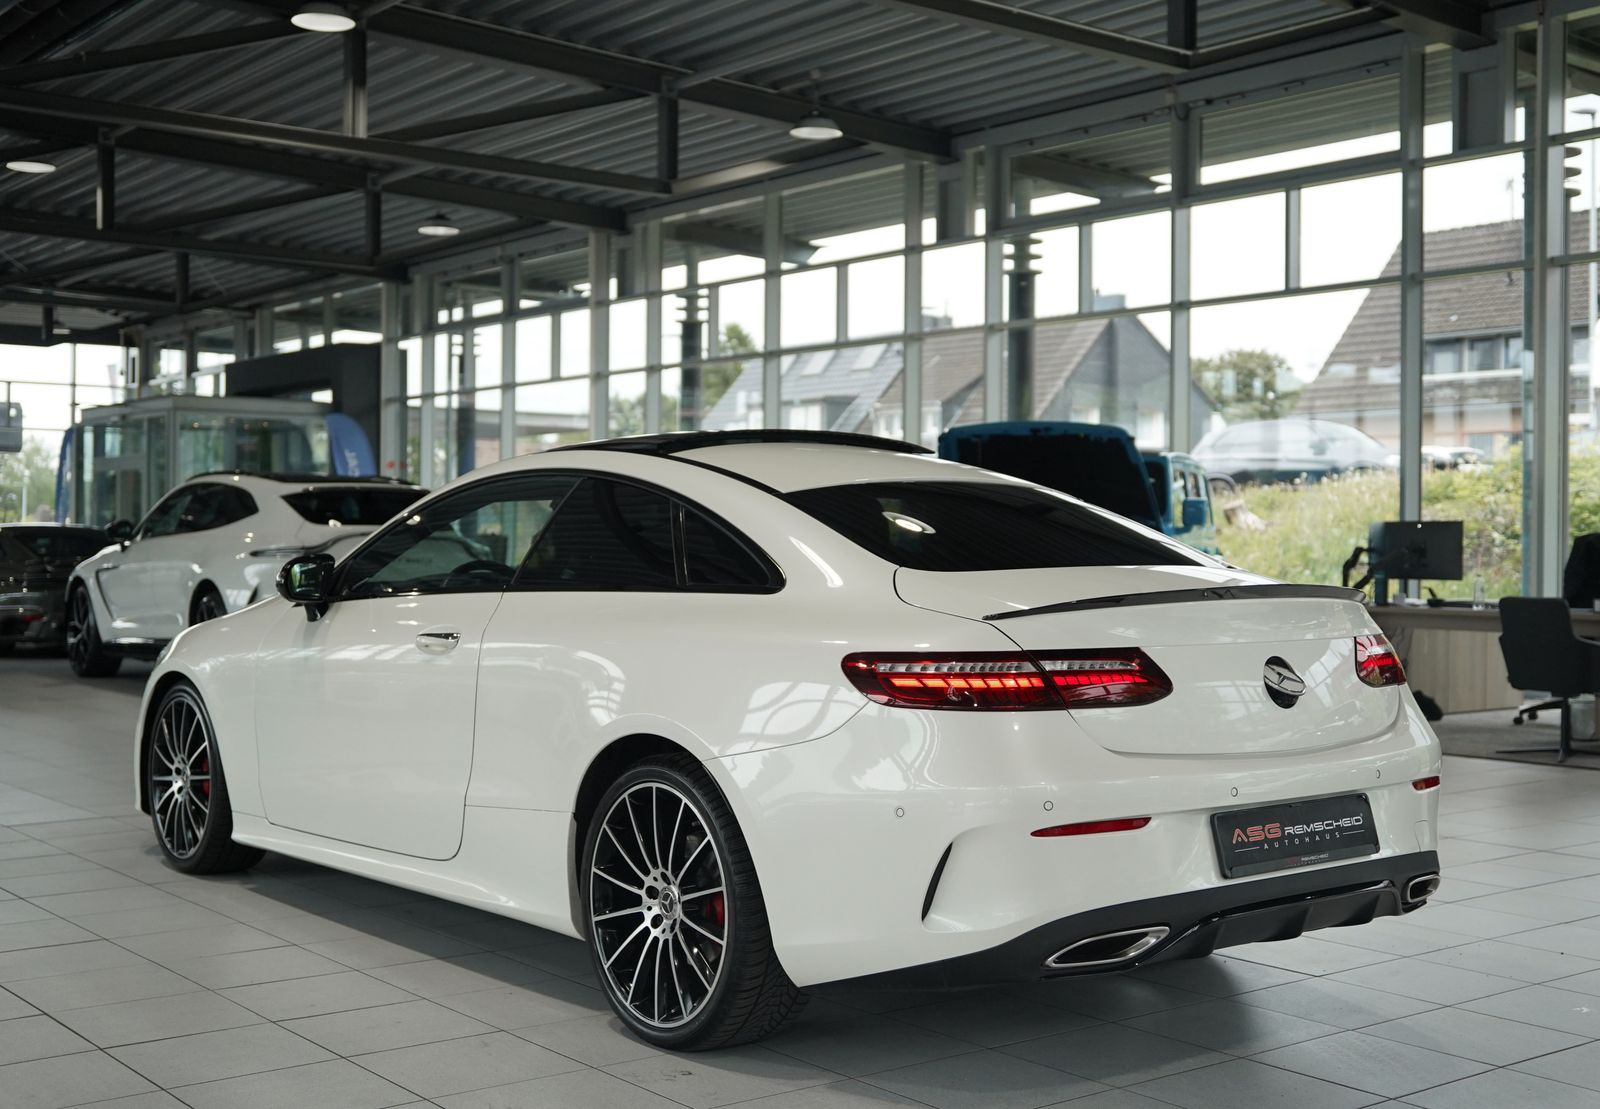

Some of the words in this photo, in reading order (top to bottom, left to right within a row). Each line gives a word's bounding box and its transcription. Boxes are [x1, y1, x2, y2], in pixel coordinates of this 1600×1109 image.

[1232, 822, 1282, 845] ASG
[1284, 815, 1364, 836] REMSCHEID
[1263, 831, 1341, 850] AUTOHAUS
